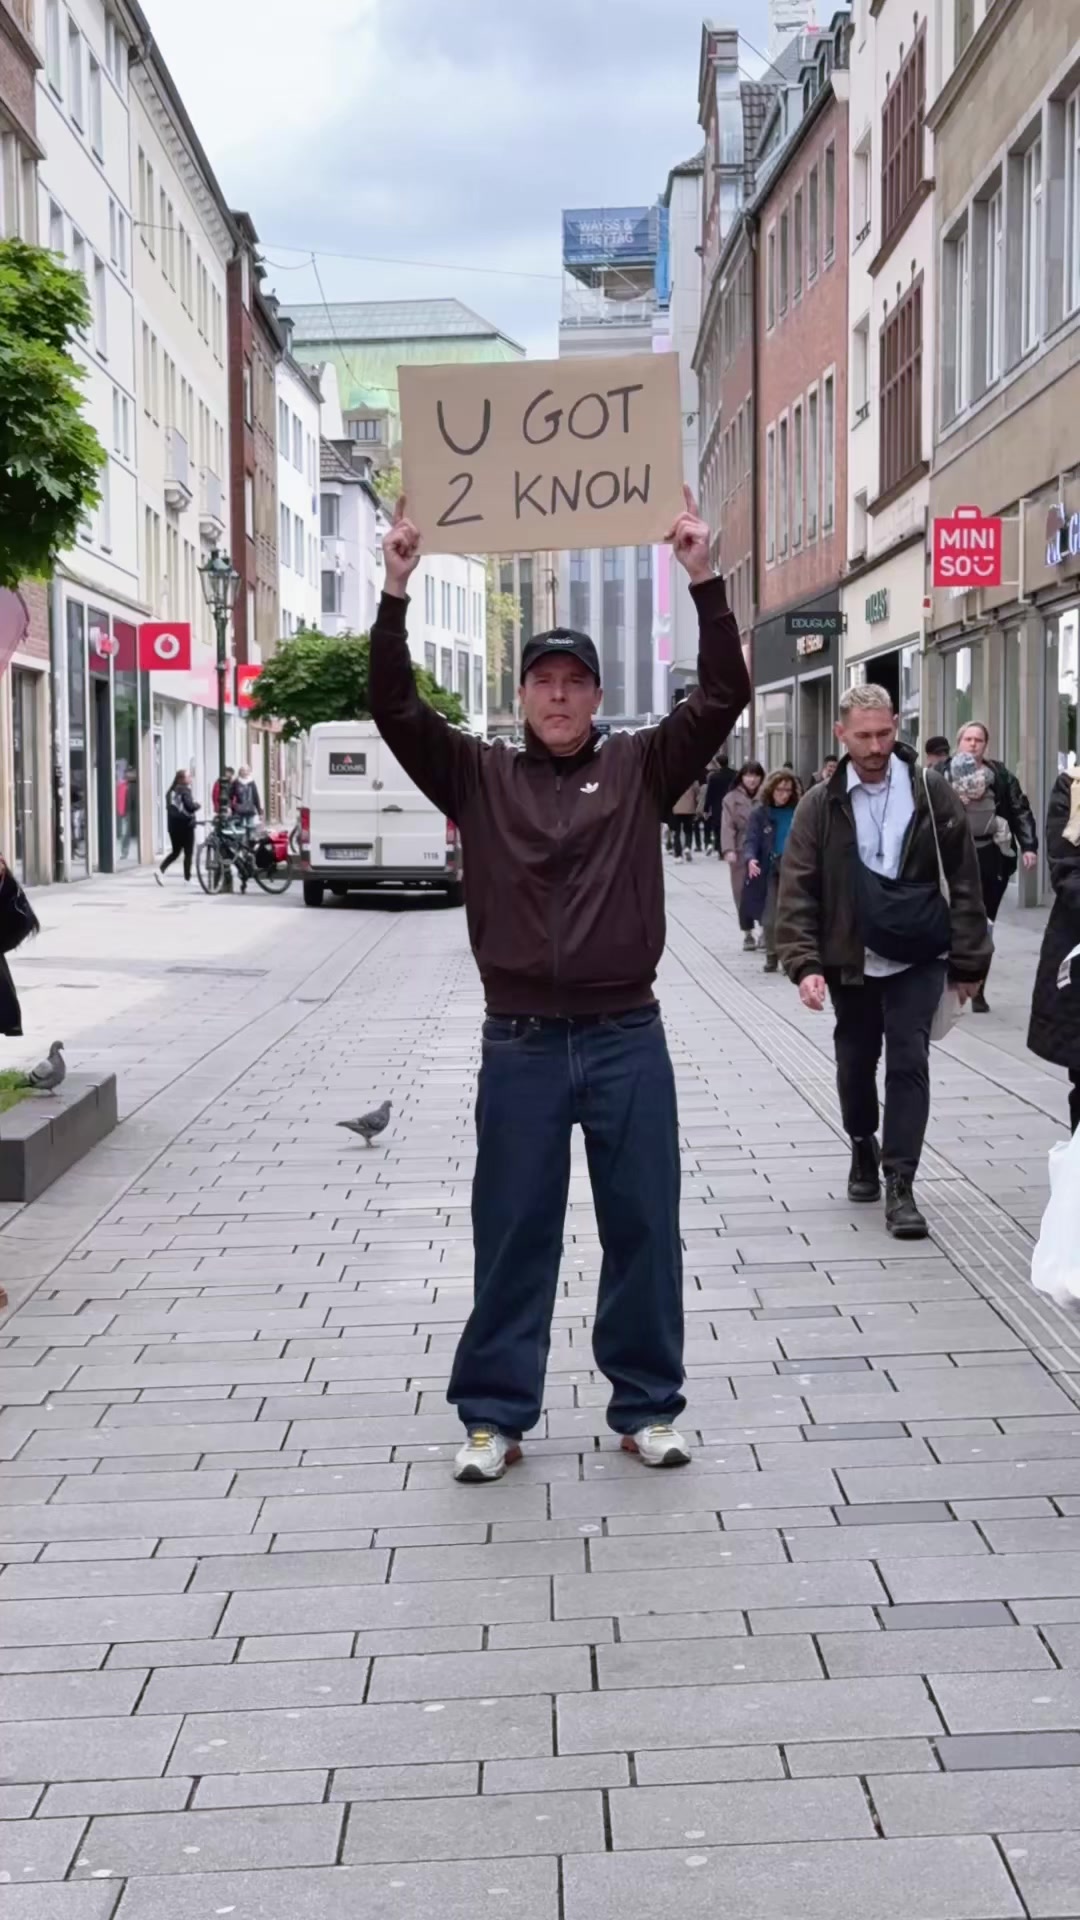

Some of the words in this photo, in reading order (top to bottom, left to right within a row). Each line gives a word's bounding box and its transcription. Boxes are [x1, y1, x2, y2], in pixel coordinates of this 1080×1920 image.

[437, 398, 490, 455] U
[522, 384, 643, 444] GOT
[436, 472, 484, 526] 2
[514, 464, 650, 519] KNOW
[940, 528, 994, 549] MINI
[791, 617, 836, 629] DOUGLAS
[331, 763, 365, 773] LOOMIS
